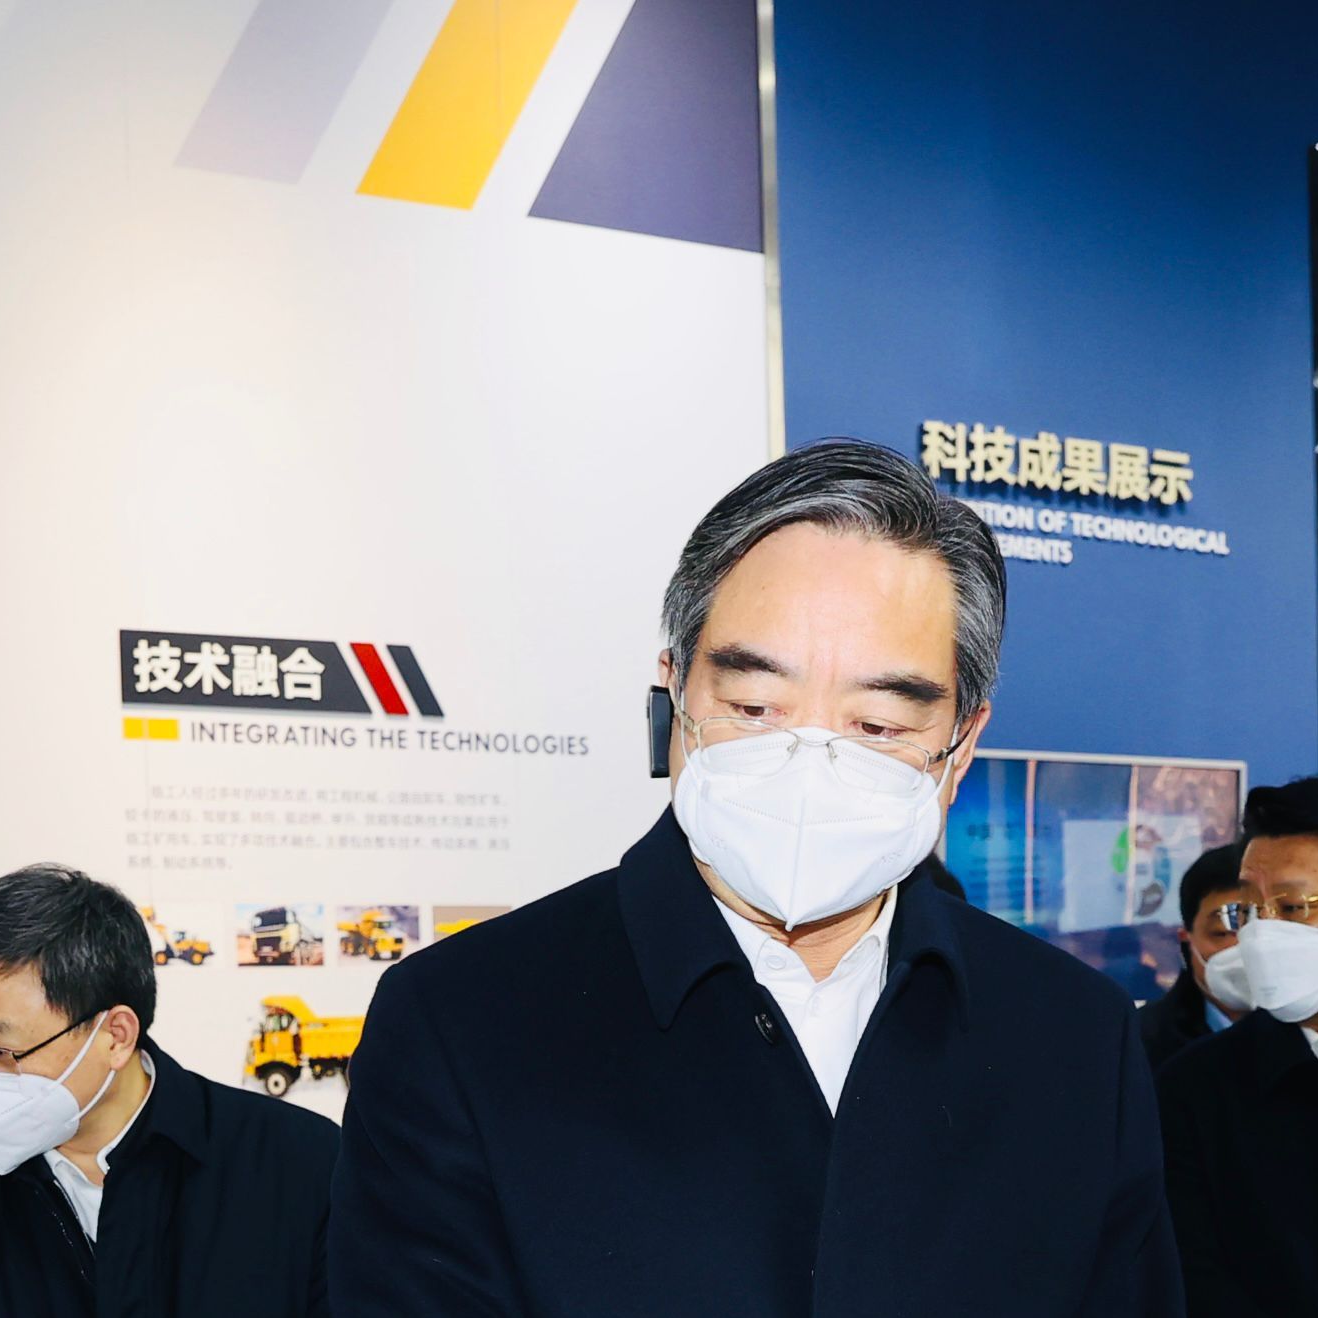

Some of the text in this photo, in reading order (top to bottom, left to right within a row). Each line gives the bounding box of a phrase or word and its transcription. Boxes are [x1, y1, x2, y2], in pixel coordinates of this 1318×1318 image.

[921, 420, 1194, 505] 科技成果展示
[1038, 509, 1068, 534] OF
[1070, 512, 1230, 556] TECHNOLOGICAL
[132, 639, 326, 702] 技术融合
[190, 721, 590, 756] INTEGRATING THE TECHNOLOGIES
